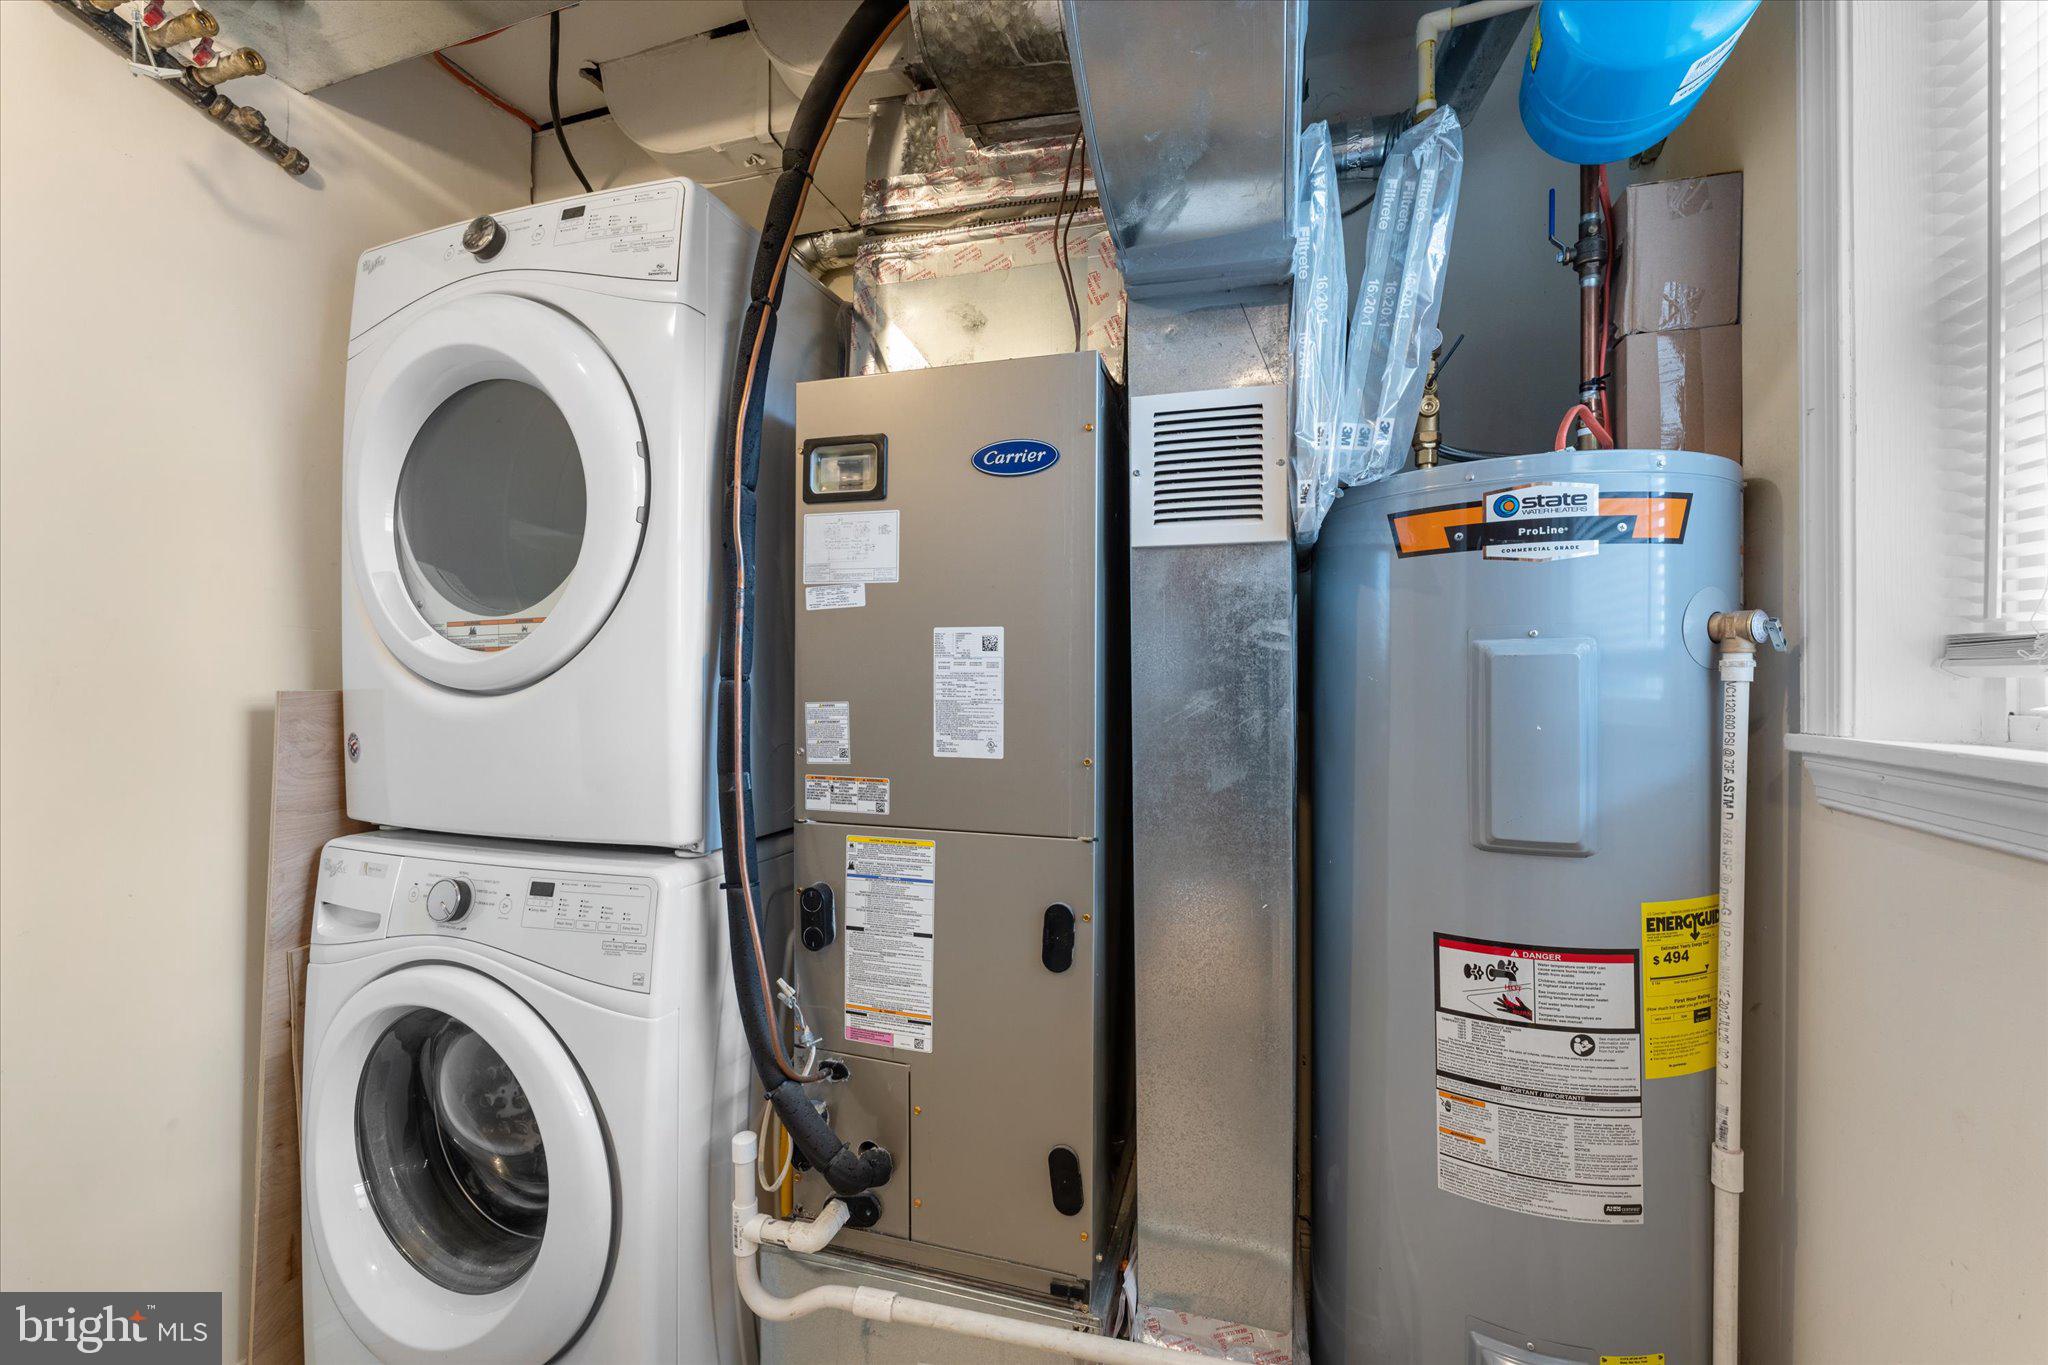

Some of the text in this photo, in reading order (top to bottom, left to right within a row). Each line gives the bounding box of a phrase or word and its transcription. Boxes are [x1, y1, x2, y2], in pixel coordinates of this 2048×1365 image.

[1378, 178, 1398, 230] Filtrete
[1416, 169, 1436, 222] Filtrete
[1396, 181, 1416, 232] Filtrete
[1299, 226, 1310, 280] Filtrete
[1362, 278, 1380, 326] 16x20x1
[1379, 281, 1398, 328] 16x20x1
[1341, 426, 1352, 446] 3M
[1358, 428, 1370, 447] 3M
[984, 450, 1046, 465] Carrier
[1522, 493, 1588, 508] state
[1725, 681, 1737, 713] VC1120
[1725, 714, 1736, 730] 600
[1724, 732, 1736, 746] PSI
[1724, 748, 1736, 757] @
[1724, 759, 1734, 775] 73F
[1723, 776, 1734, 808] ASTM
[1646, 909, 1719, 933] ENERGYGUID
[1522, 952, 1561, 961] DANGER
[1653, 950, 1689, 965] $ 494
[1500, 1086, 1538, 1096] IMPORTANT
[1544, 1092, 1586, 1102] IMPORTANTE
